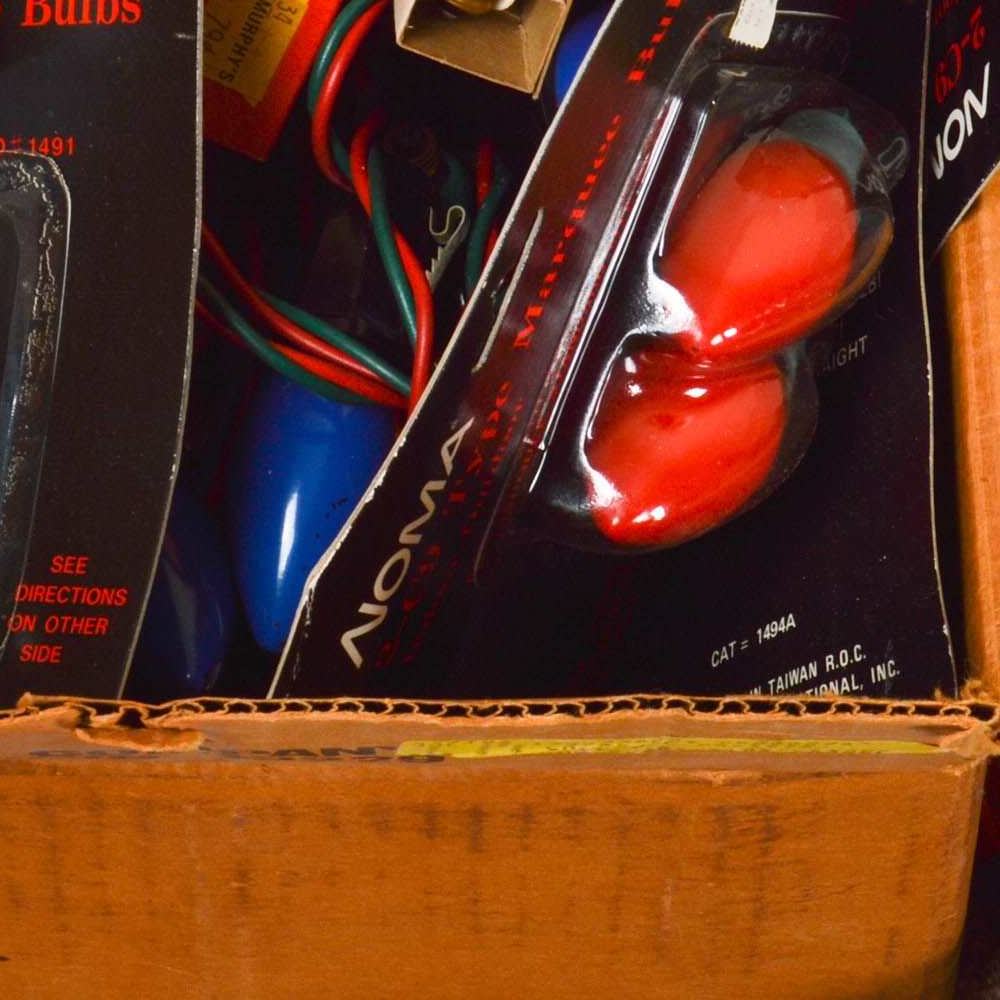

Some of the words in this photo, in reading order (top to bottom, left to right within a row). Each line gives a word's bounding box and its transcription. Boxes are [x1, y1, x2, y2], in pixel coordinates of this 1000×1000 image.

[28, 136, 75, 157] 1491
[341, 417, 474, 669] NOMA
[50, 556, 89, 574] SEE
[16, 584, 128, 606] DIRECTIONS
[10, 614, 37, 632] ON
[45, 615, 109, 635] OTHER
[711, 641, 738, 668] CAT
[756, 613, 797, 645] 1494A
[20, 645, 63, 663] SIDE
[767, 660, 818, 696] TAIWAN
[825, 644, 867, 672] R.O.C.
[870, 660, 901, 684] INC.
